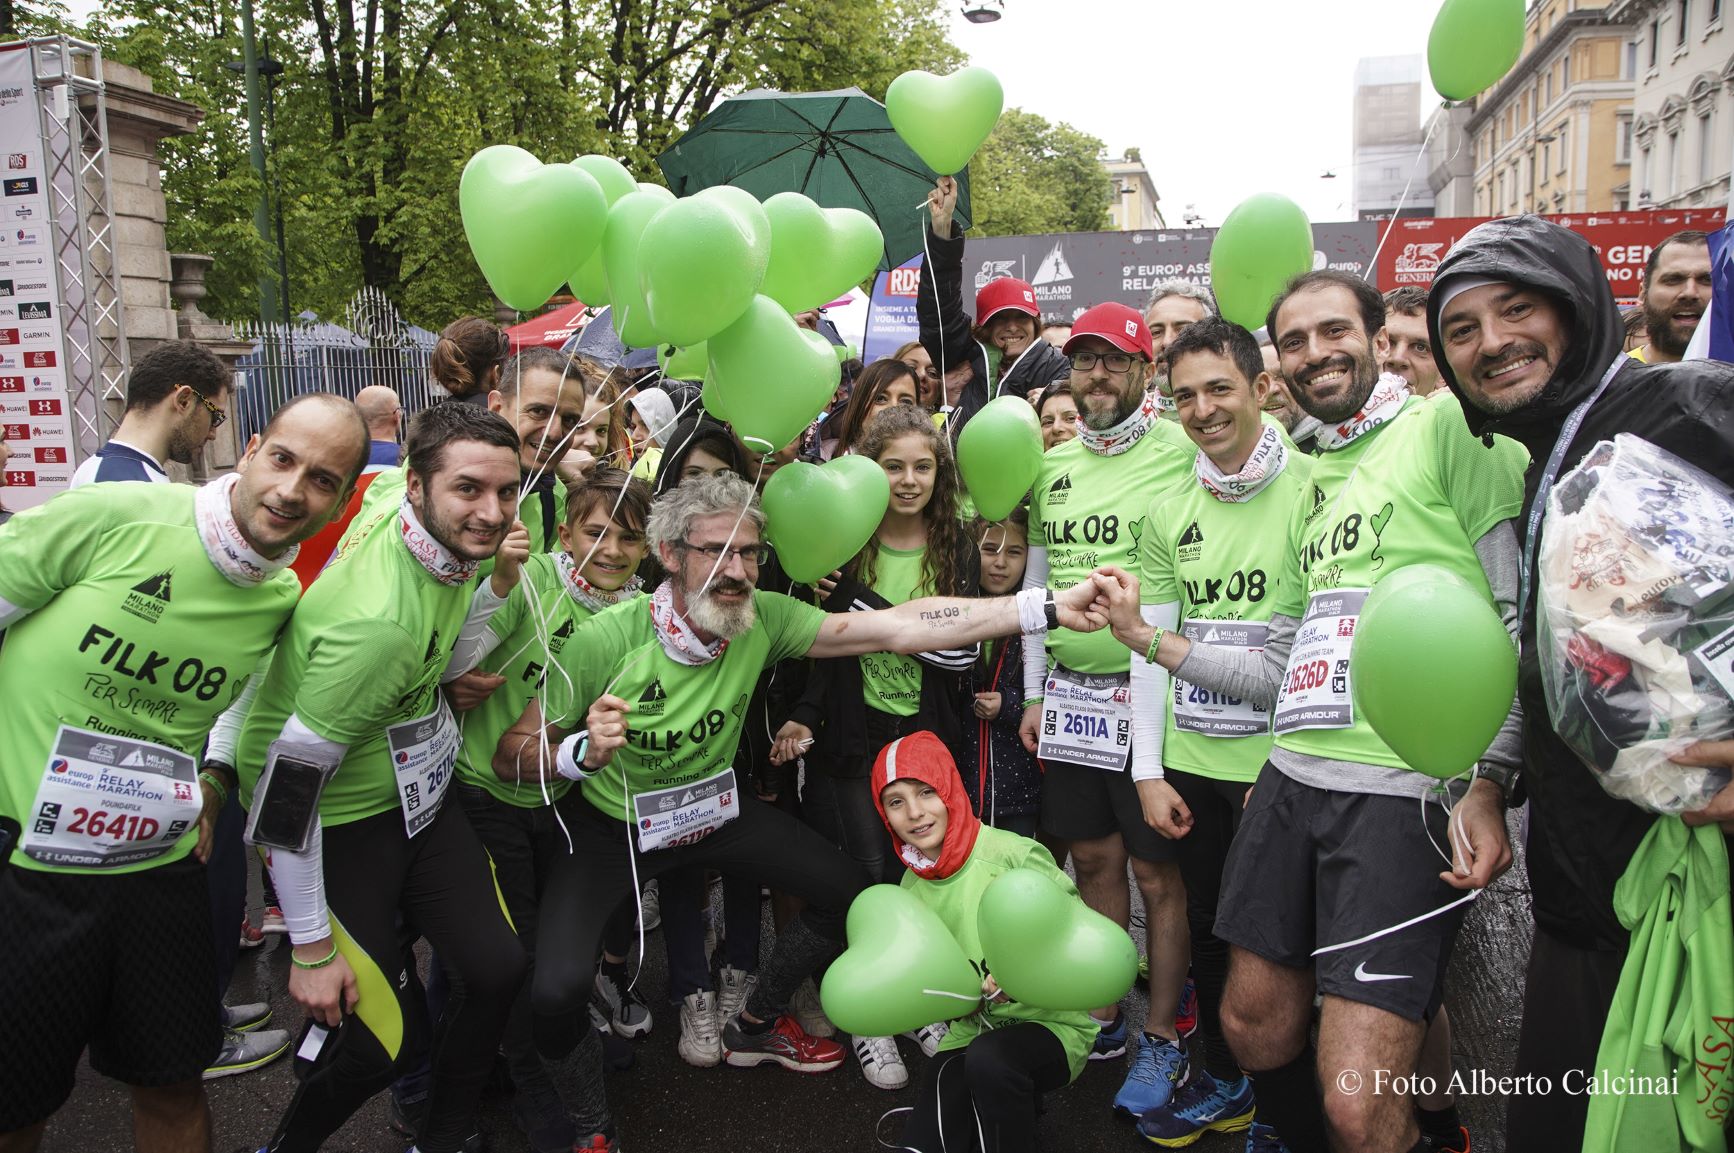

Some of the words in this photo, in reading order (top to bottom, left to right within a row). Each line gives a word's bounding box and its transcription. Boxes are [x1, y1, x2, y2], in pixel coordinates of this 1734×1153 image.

[1138, 264, 1184, 276] EUROP
[1328, 261, 1362, 273] europ
[891, 269, 921, 291] RDS
[1034, 285, 1072, 294] MILANO
[874, 315, 905, 323] VOGLIA
[1132, 425, 1147, 441] 08
[1254, 443, 1272, 464] FILK
[1083, 515, 1119, 545] 08
[1331, 513, 1363, 557] 08
[409, 531, 438, 559] CASA
[1178, 546, 1202, 555] MILANO
[1183, 578, 1223, 606] ILK
[1226, 568, 1267, 602] 08
[1641, 574, 1678, 602] europ
[124, 599, 160, 619] MARATHON
[127, 592, 164, 615] MILANO
[1318, 600, 1343, 609] MILANO
[920, 610, 942, 620] FILK
[943, 606, 960, 618] 08
[1220, 630, 1248, 638] MILANO
[78, 623, 170, 685] FILK
[173, 657, 227, 701] 08
[1094, 677, 1118, 685] MILANO
[1288, 660, 1329, 695] 2626D
[84, 672, 118, 710] PER
[878, 690, 917, 700] Running
[1070, 694, 1107, 704] MARATHON
[638, 702, 665, 711] MILANO
[1300, 711, 1341, 721] ARMOUR
[85, 715, 148, 741] Running
[625, 728, 684, 752] FILK
[688, 709, 725, 744] 08
[1064, 712, 1109, 739] 2611A
[1187, 720, 1211, 729] UNDER
[1213, 723, 1258, 731] ARMOUR
[146, 754, 174, 767] MILANO
[409, 750, 428, 761] europ
[1058, 750, 1085, 758] UNDER
[1086, 753, 1120, 764] ARMOUR
[398, 756, 428, 772] assistance
[47, 775, 92, 789] assistance
[68, 770, 94, 781] europ
[99, 774, 145, 789] RELAY
[653, 772, 700, 785] Running
[96, 784, 163, 801] MARATHON
[101, 800, 142, 812] POUND4FILK
[672, 807, 700, 822] RELAY
[673, 809, 714, 828] MARATHON
[711, 815, 723, 823] TEAM
[66, 807, 159, 841] 2641D
[642, 825, 671, 836] assistance
[652, 819, 670, 828] europ
[54, 854, 103, 864] UNDER
[105, 851, 161, 864] ARMOUR
[1696, 1015, 1734, 1104] CASA
